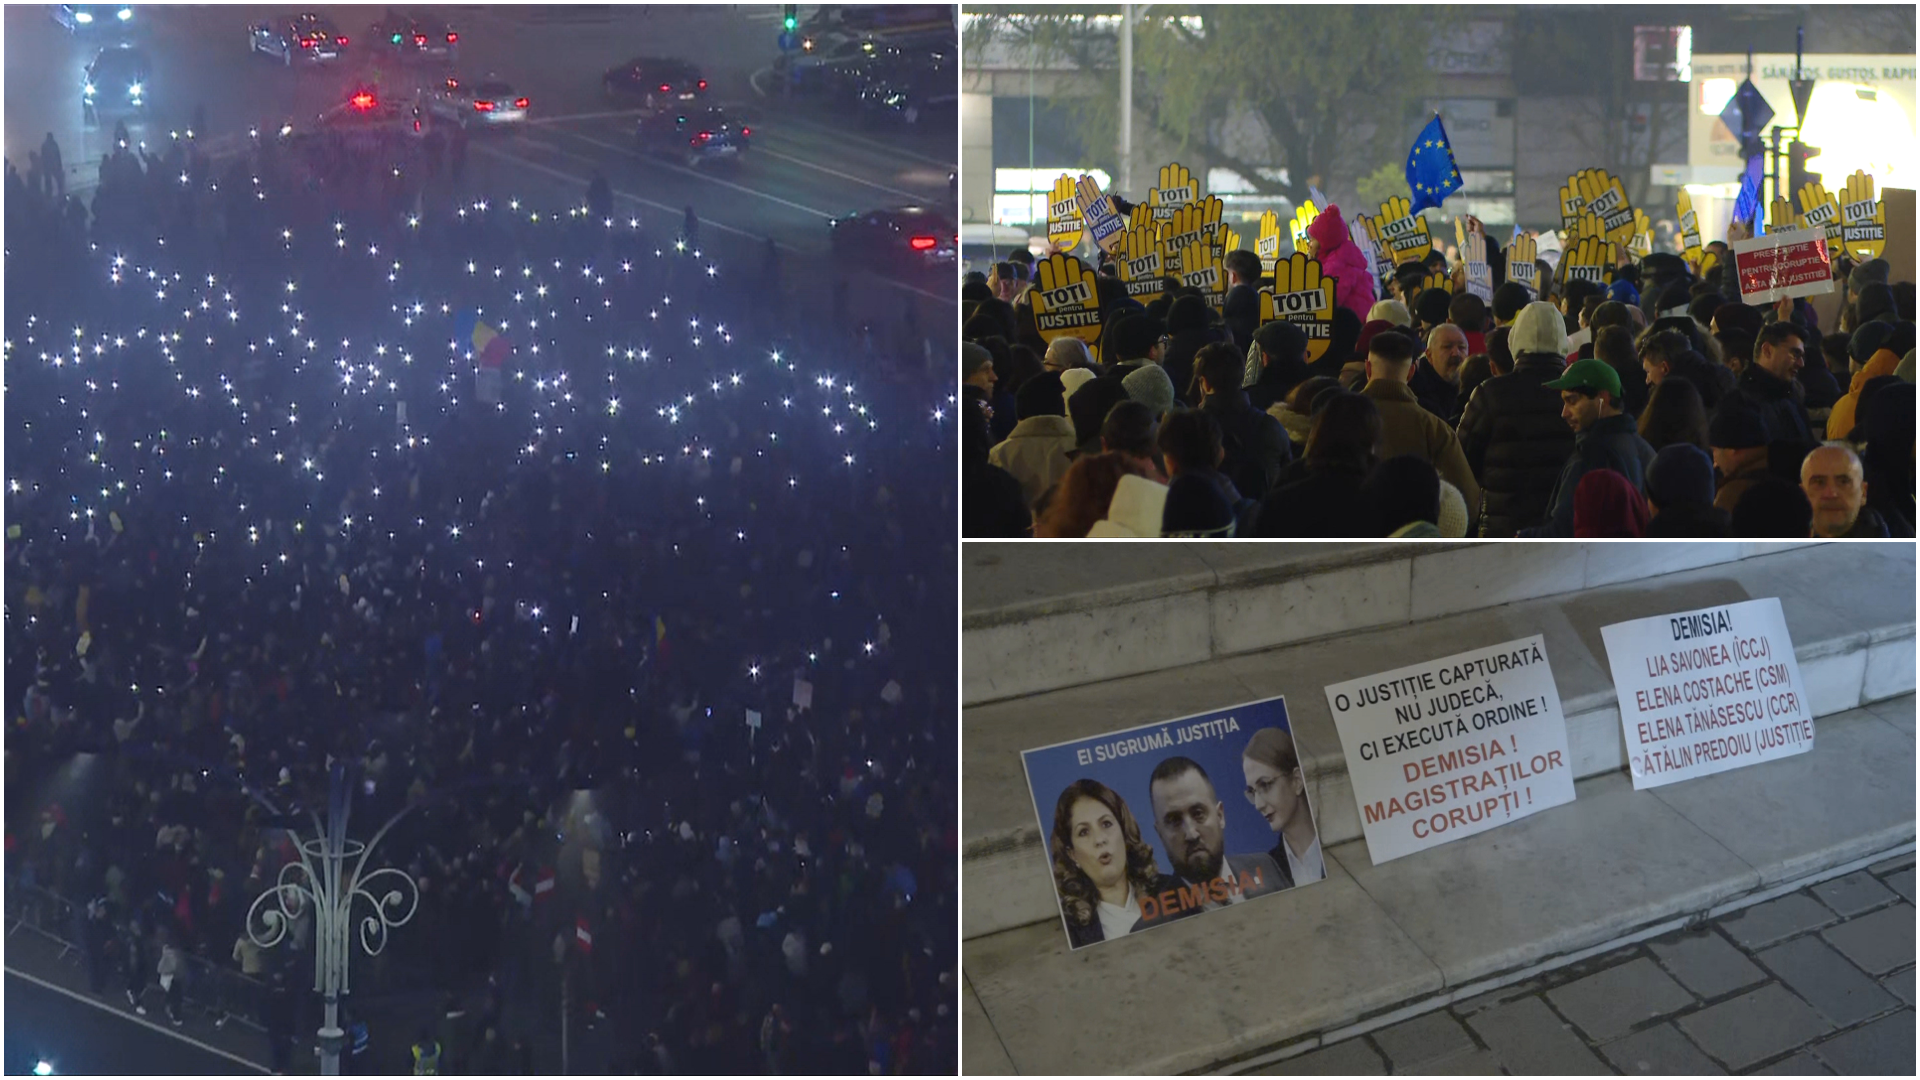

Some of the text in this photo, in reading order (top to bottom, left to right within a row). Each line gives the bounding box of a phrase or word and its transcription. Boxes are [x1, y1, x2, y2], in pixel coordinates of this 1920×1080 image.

[1058, 304, 1083, 316] pentru
[1670, 609, 1733, 641] DEMISIA!
[1335, 642, 1544, 712] O JUSTIȚIE CAPTURATĂ
[1646, 654, 1670, 678] LIA
[1671, 644, 1731, 674] SAVONEA
[1395, 679, 1504, 725] NU JUDECĂ,
[1636, 663, 1791, 712] ELENA COSTACHE (CSM)
[1077, 716, 1240, 766] EI SUGRUMĂ JUSTIȚIA
[1359, 741, 1379, 761] CI
[1382, 713, 1469, 755] EXECUTĂ
[1472, 699, 1538, 731] ORDINE
[1637, 691, 1801, 744] ELENA TĂNĂSESCU (CCR)
[1403, 738, 1506, 783] DEMISIA
[1694, 732, 1752, 765] PREDOIU
[1363, 750, 1564, 824] MAGISTRAȚILOR
[1412, 791, 1520, 839] CORUPȚI
[1138, 866, 1265, 922] DEMISIA!
